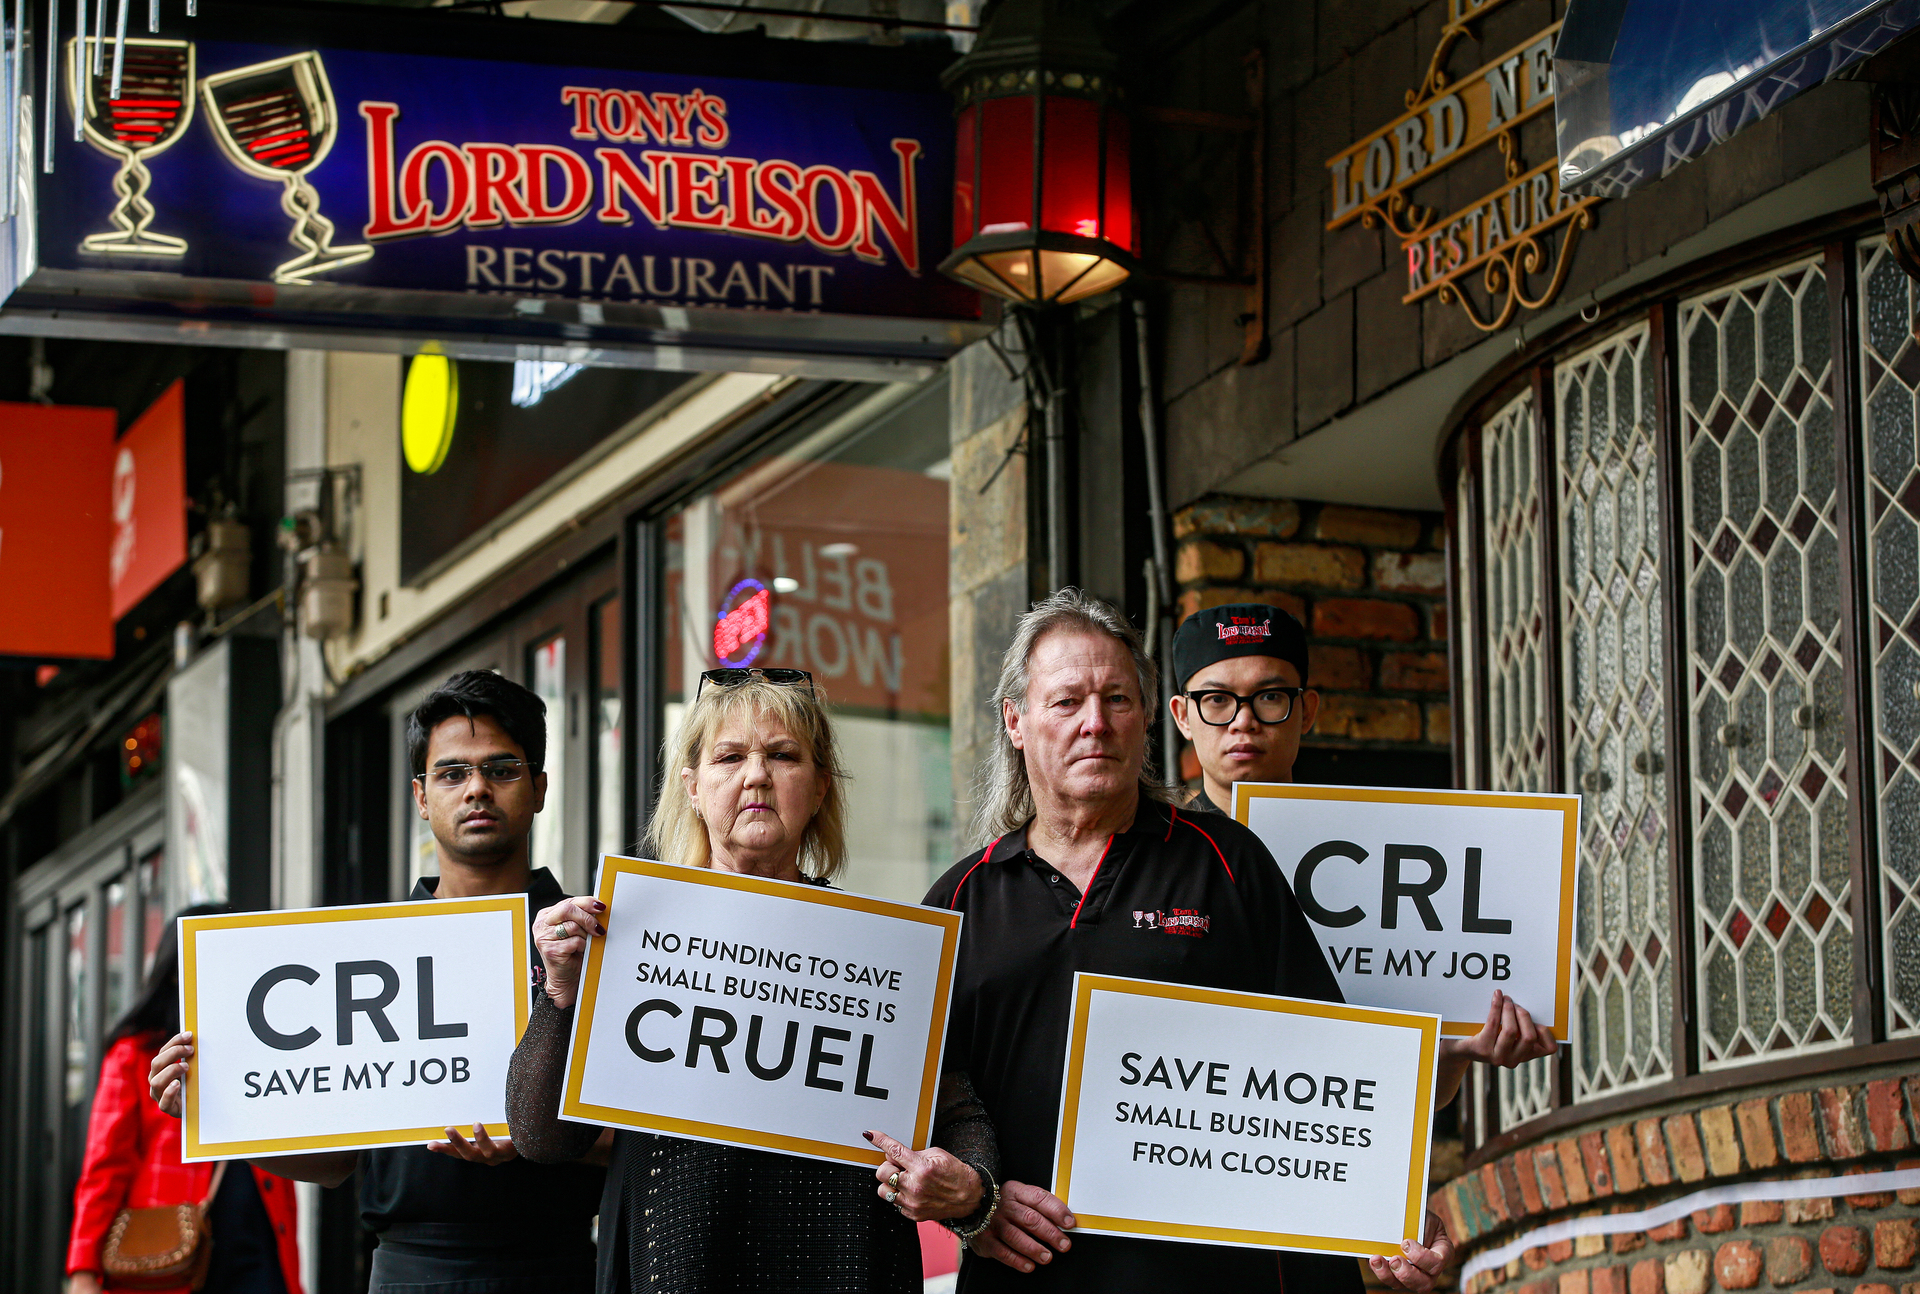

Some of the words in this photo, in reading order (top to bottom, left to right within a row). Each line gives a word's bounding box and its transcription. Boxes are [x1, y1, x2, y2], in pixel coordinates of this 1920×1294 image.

[561, 86, 730, 149] TONY'S
[1331, 93, 1466, 220] LORD
[359, 102, 594, 242] LORD
[596, 138, 922, 277] NELSON
[465, 244, 835, 304] RESTAURANT
[1293, 840, 1512, 934] CRL
[641, 929, 681, 953] NO
[687, 936, 802, 973] FUNDING
[808, 956, 839, 979] TO
[843, 963, 902, 991] SAVE
[1328, 946, 1373, 974] VE
[1383, 948, 1437, 977] MY
[1442, 951, 1511, 981] JOB
[246, 956, 468, 1050] CRL
[636, 962, 716, 993] SMALL
[723, 976, 870, 1019] BUSINESSES
[876, 1001, 897, 1023] IS
[244, 1066, 331, 1098] SAVE
[342, 1061, 395, 1091] MY
[402, 1056, 470, 1087] JOB
[625, 998, 889, 1100] CRUEL
[1119, 1052, 1230, 1095] SAVE
[1242, 1066, 1377, 1111] MORE
[1115, 1101, 1201, 1131] SMALL
[1210, 1112, 1372, 1148] BUSINESSES
[1132, 1141, 1212, 1169] FROM
[1221, 1151, 1348, 1182] CLOSURE
